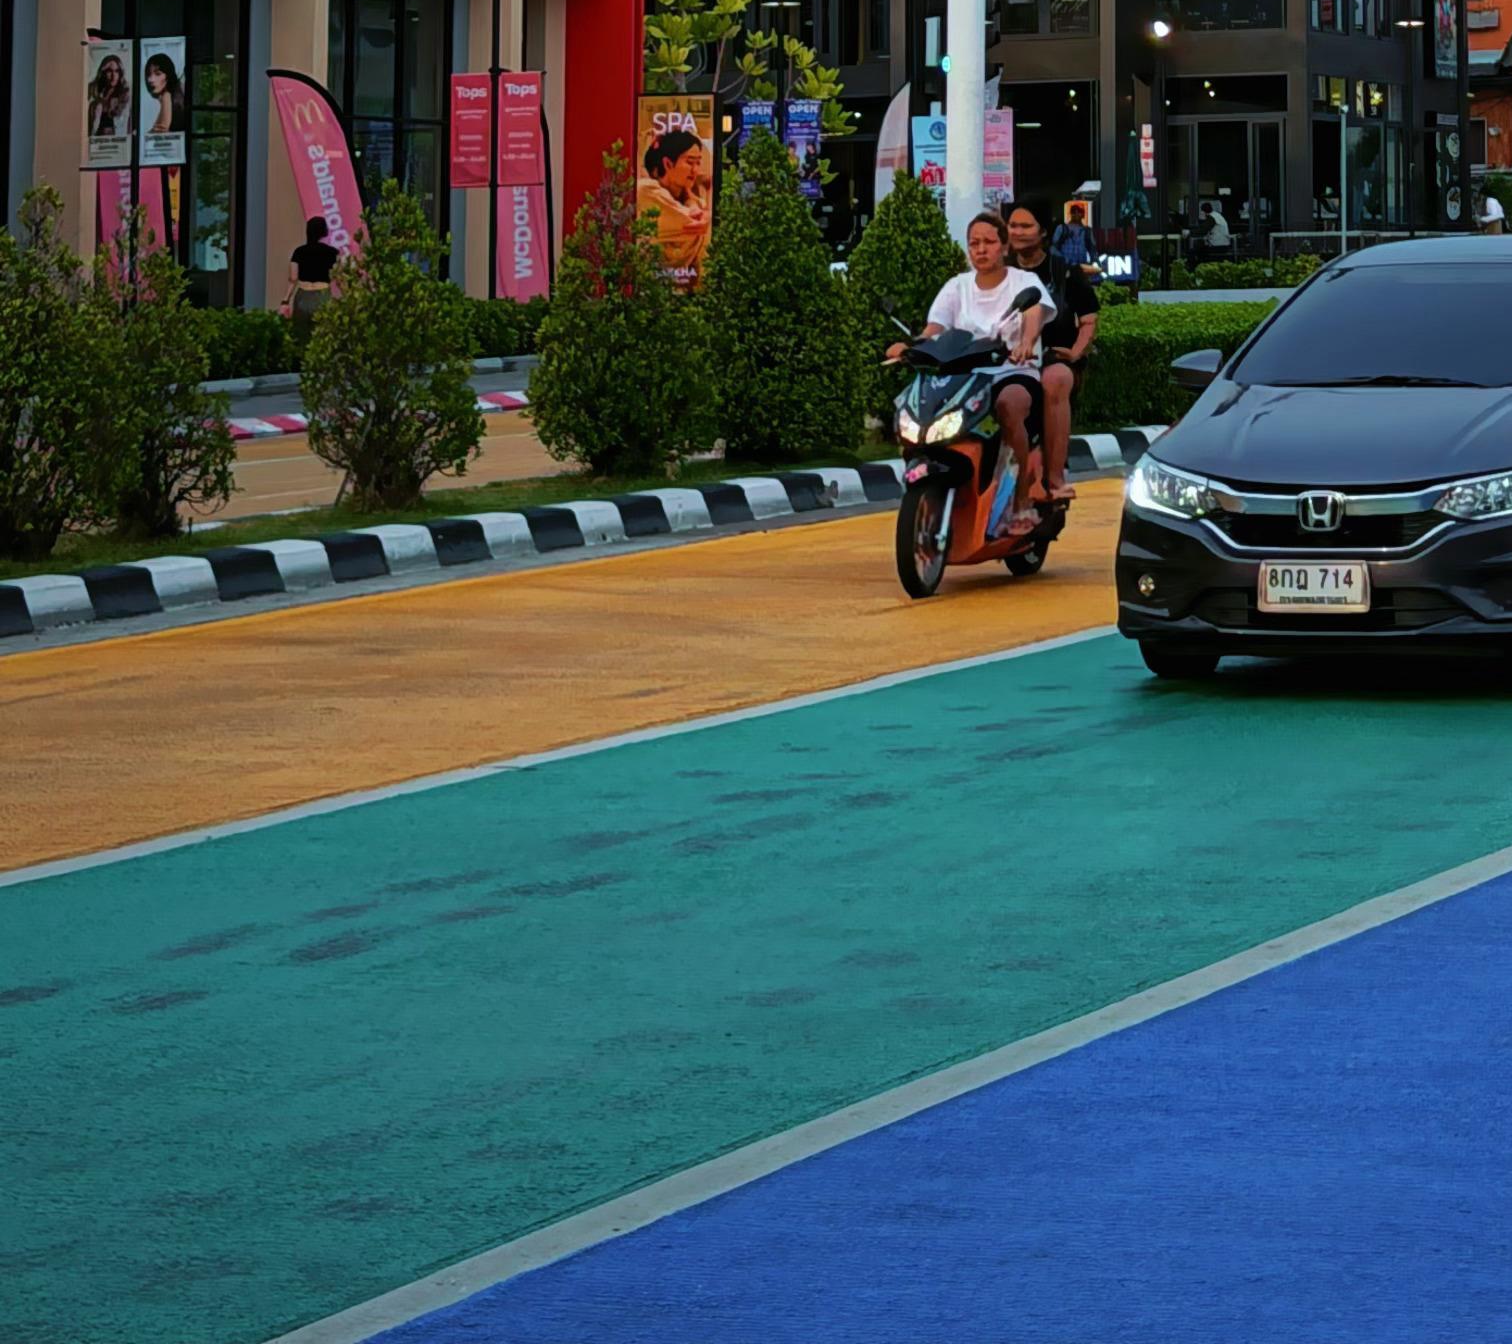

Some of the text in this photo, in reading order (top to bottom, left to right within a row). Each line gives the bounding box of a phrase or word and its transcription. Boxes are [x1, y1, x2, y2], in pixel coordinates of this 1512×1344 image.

[456, 86, 488, 100] Tops
[505, 83, 538, 97] Tops
[788, 104, 819, 114] OPEN
[652, 111, 698, 134] SPA
[1318, 568, 1354, 589] 714
